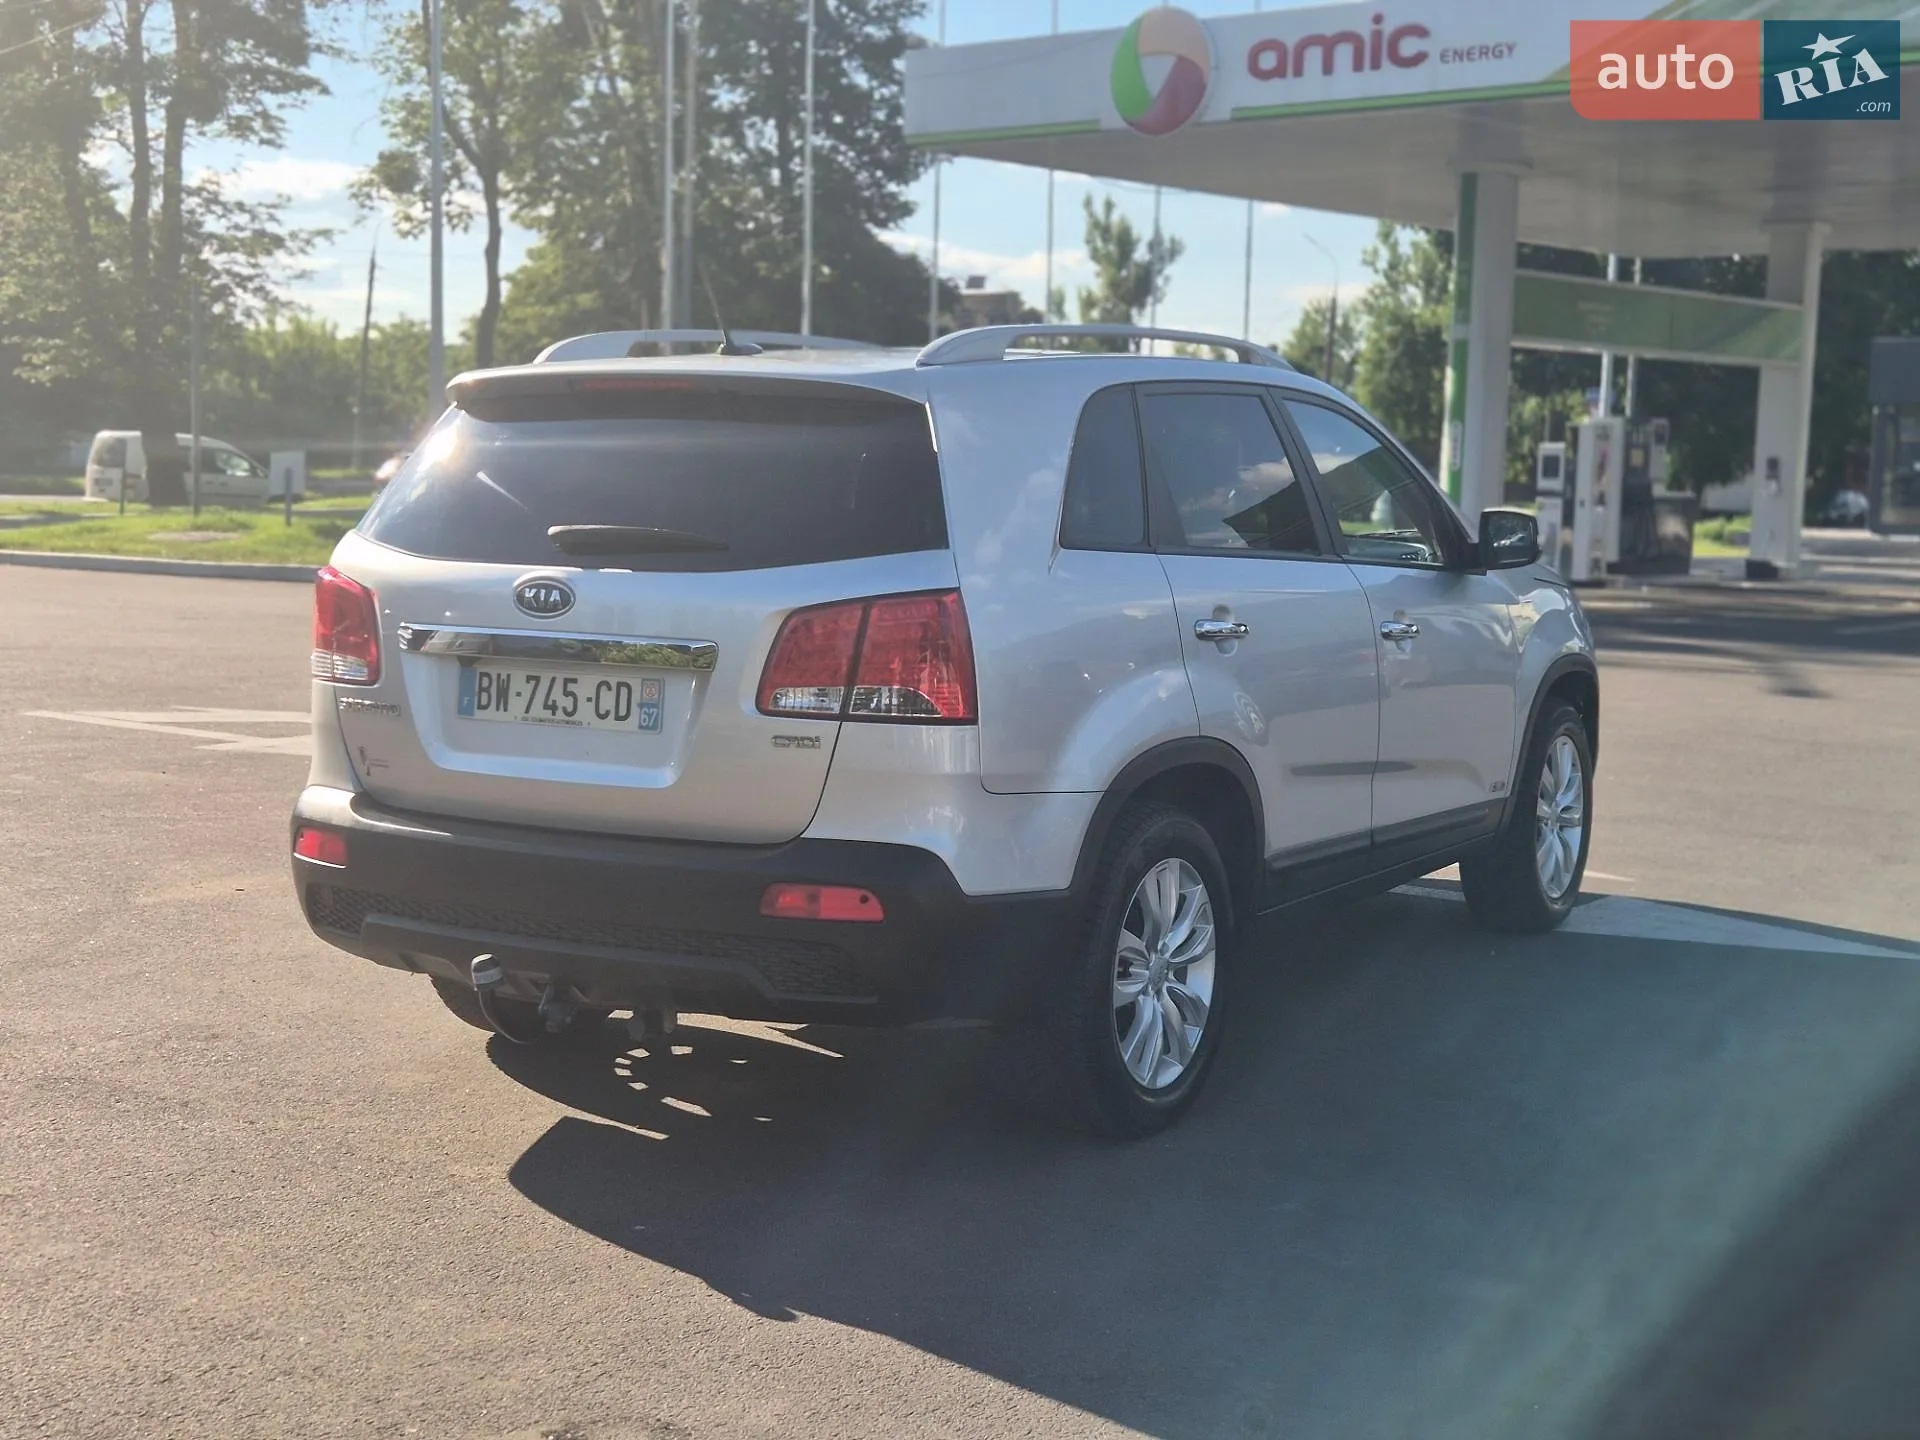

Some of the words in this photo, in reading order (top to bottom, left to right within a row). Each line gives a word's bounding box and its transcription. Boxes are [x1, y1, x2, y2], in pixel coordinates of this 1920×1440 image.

[1247, 12, 1431, 81] amic
[1439, 42, 1517, 64] ENERGY
[524, 587, 562, 609] KIA
[476, 671, 633, 722] BW-745-CD
[640, 707, 658, 728] 67
